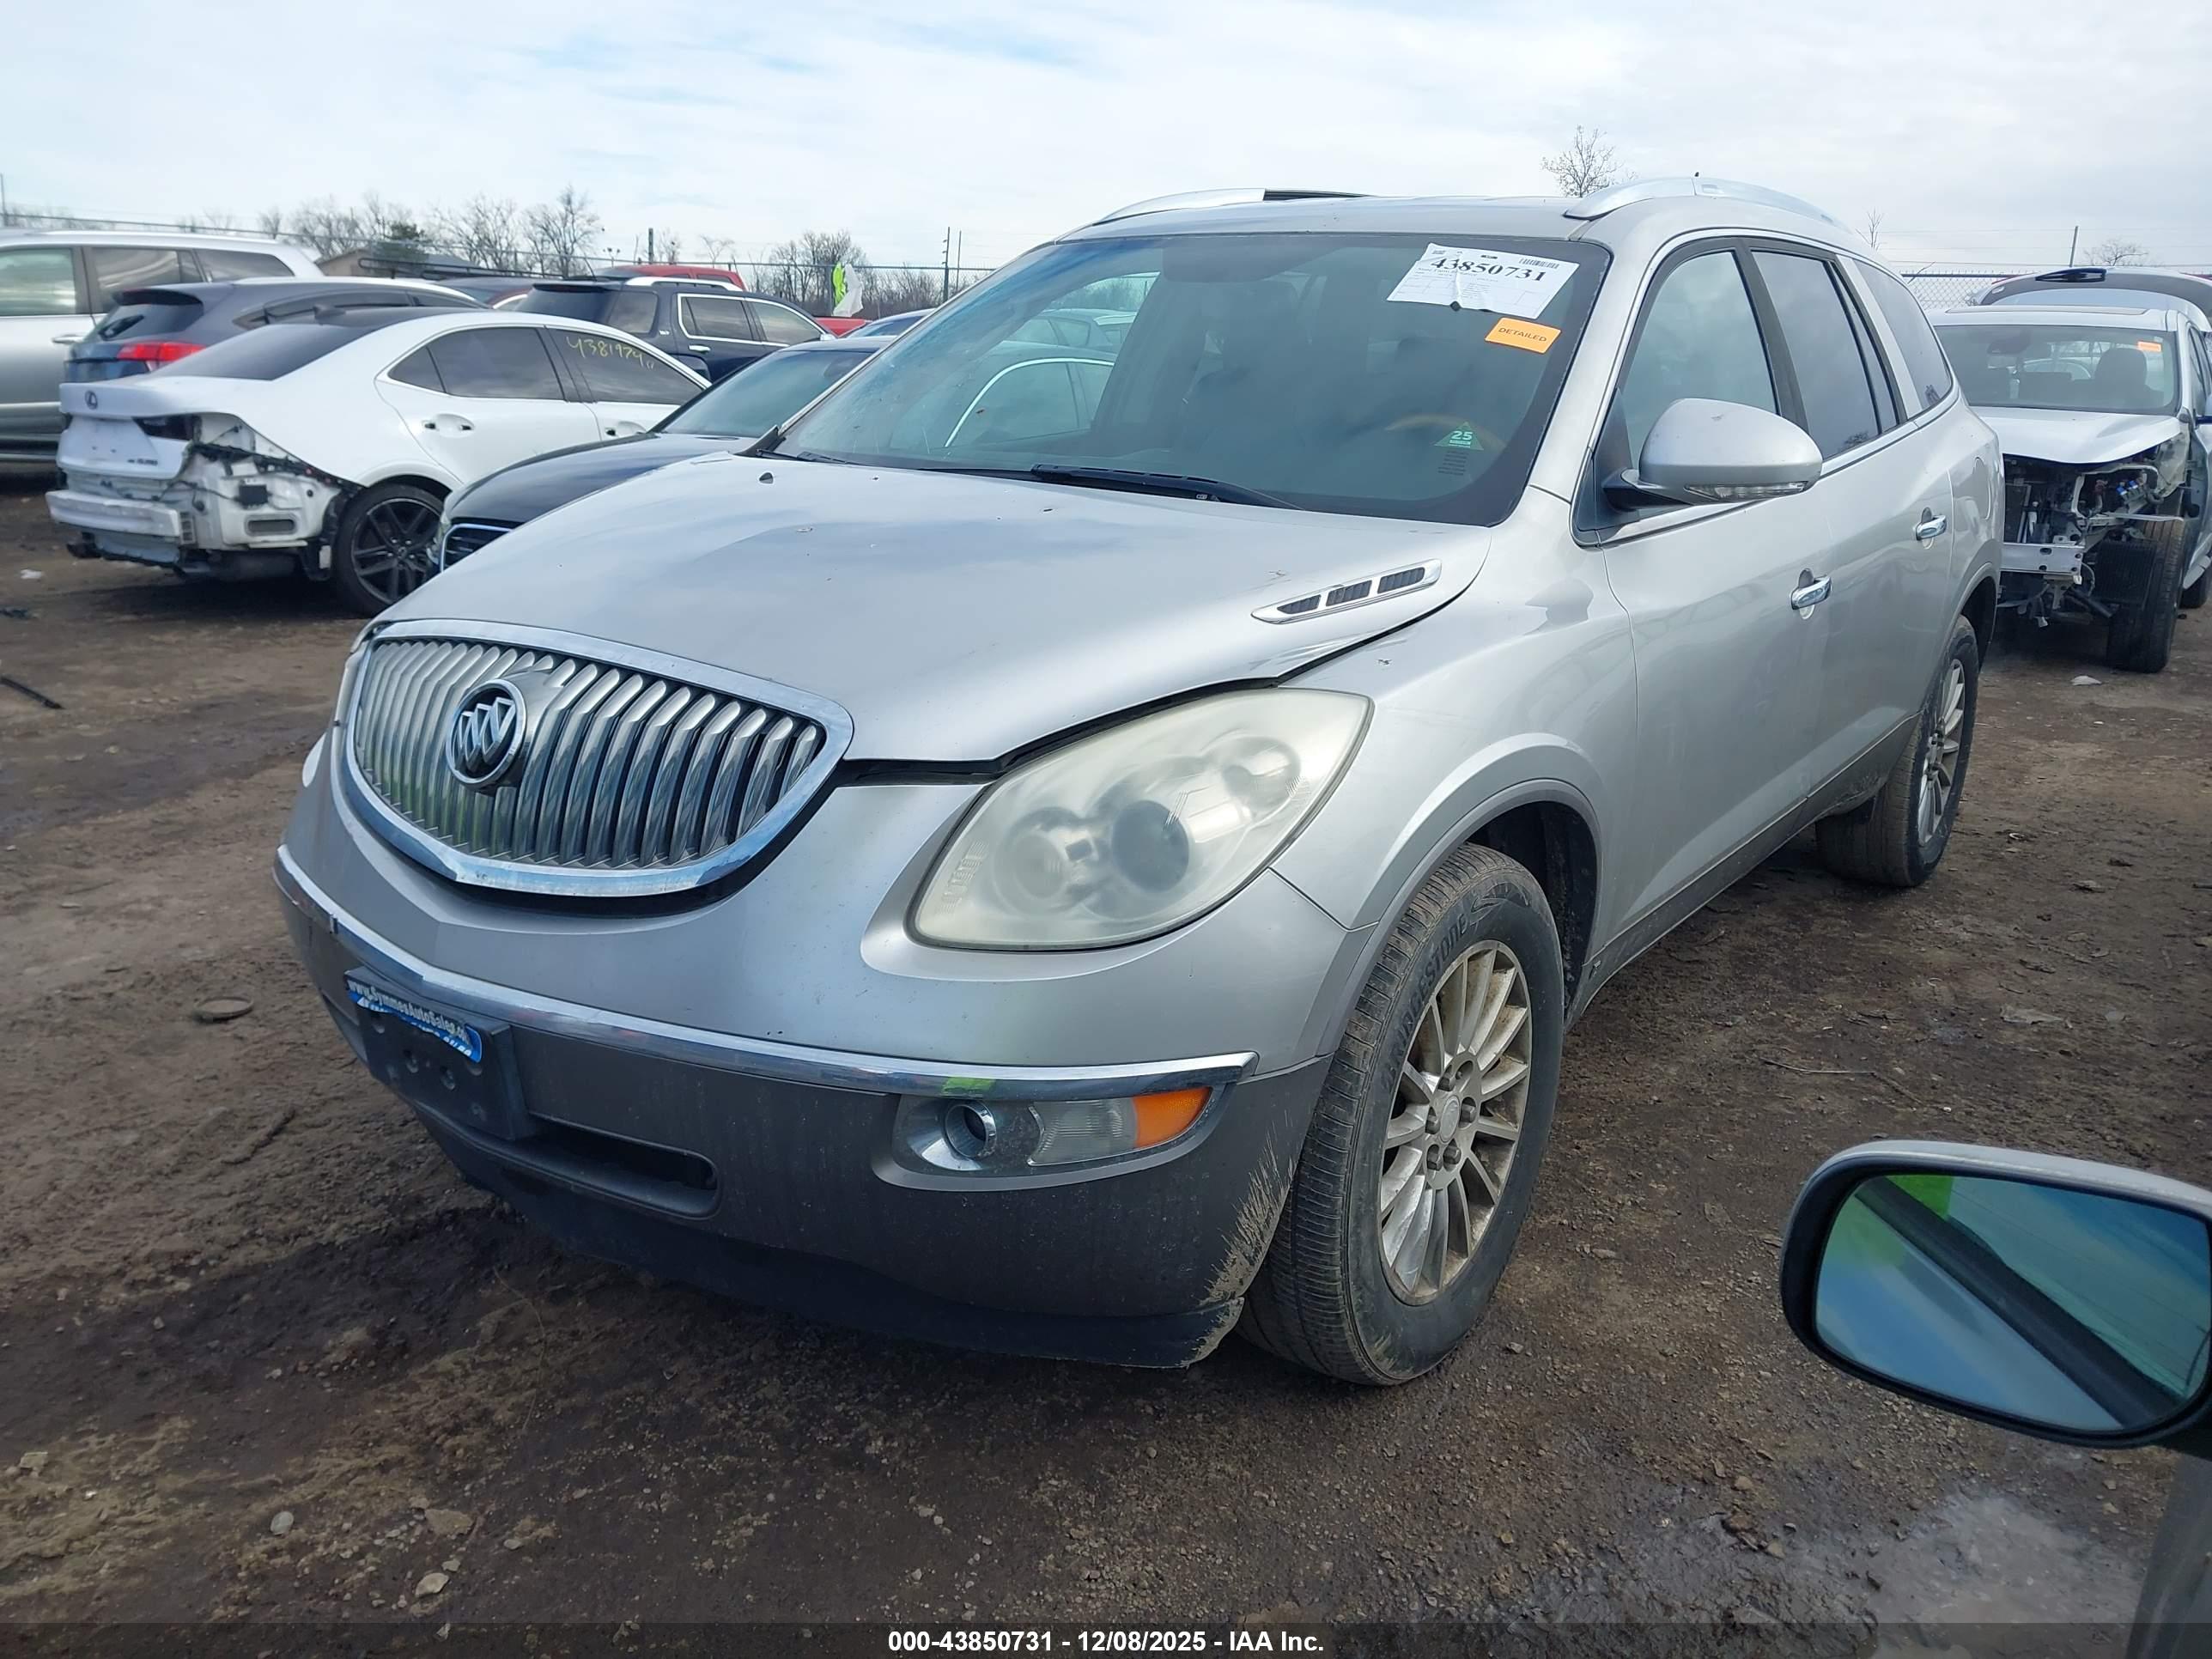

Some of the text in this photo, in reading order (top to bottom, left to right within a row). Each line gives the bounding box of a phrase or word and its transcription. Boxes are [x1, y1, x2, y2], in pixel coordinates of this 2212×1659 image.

[1431, 257, 1547, 282] 43850731
[1498, 326, 1547, 342] DETAILED
[1450, 430, 1474, 441] 25
